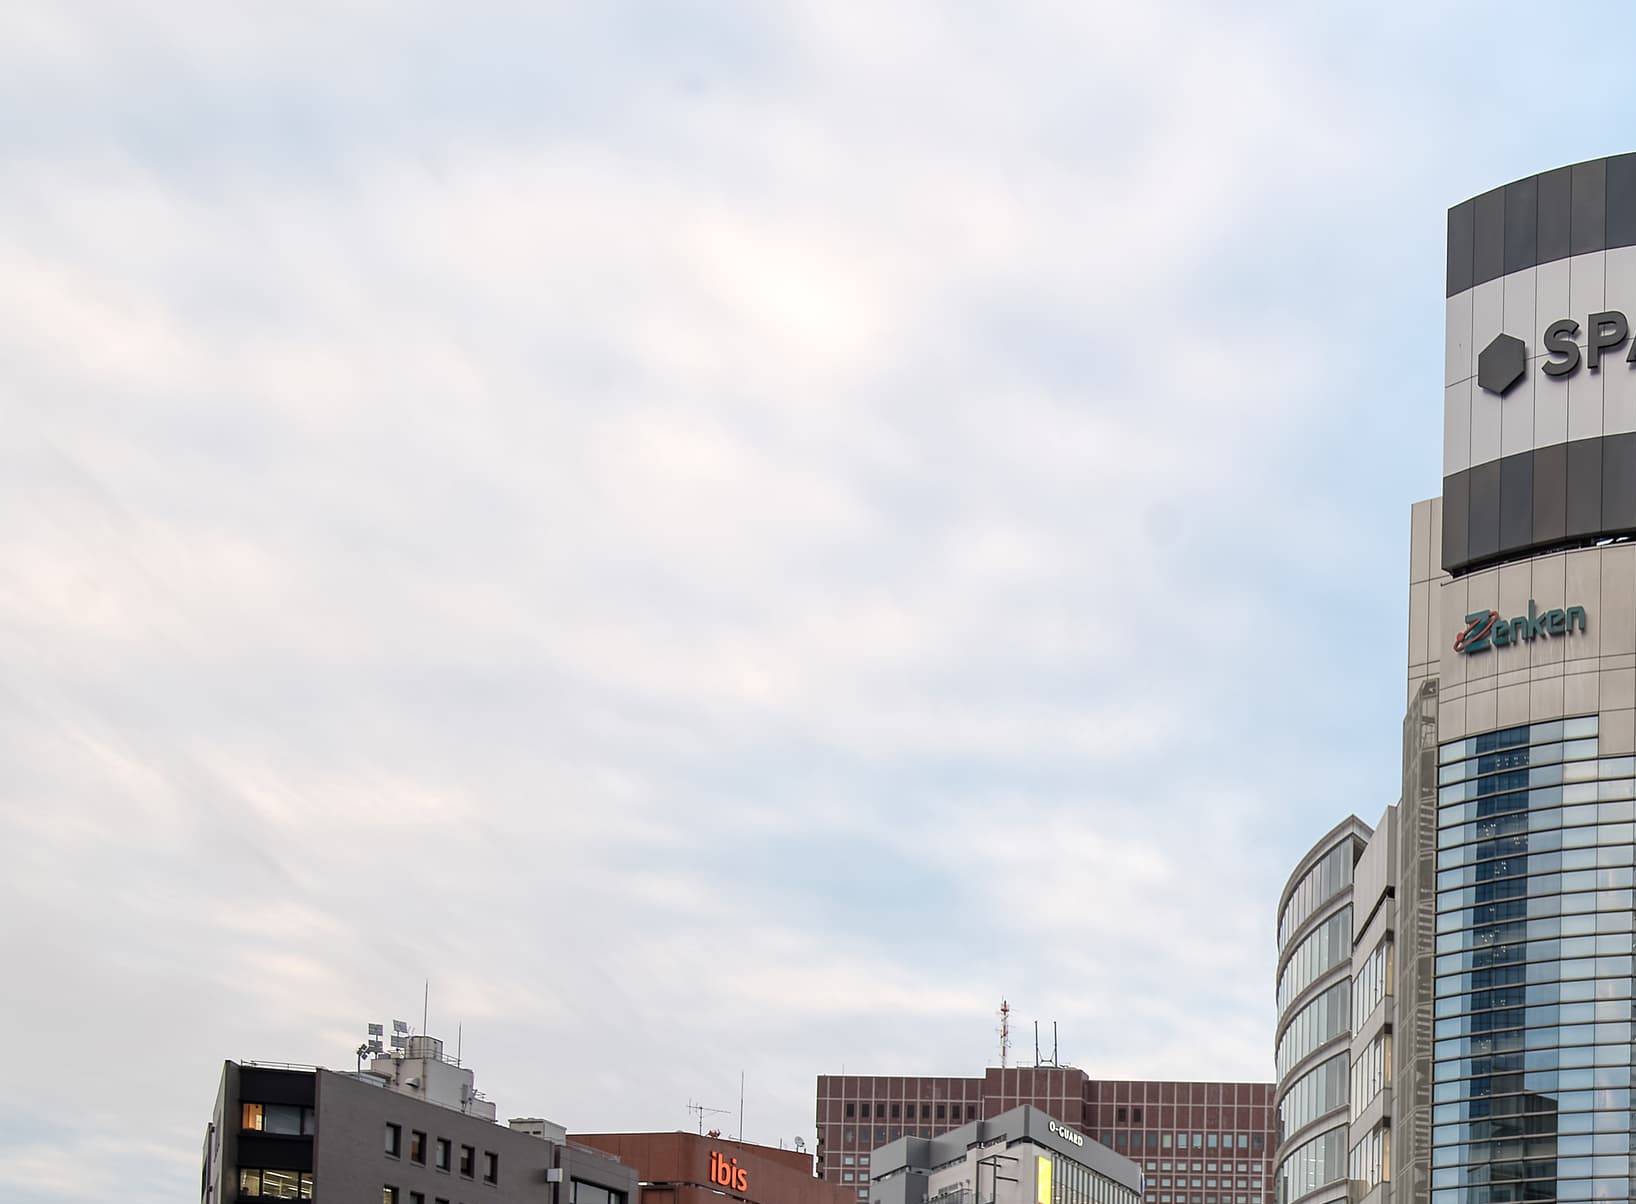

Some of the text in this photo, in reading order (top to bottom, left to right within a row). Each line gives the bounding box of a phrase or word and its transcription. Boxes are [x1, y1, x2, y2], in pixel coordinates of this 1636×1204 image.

[1462, 600, 1586, 652] Zenken
[1049, 1120, 1084, 1147] O-GUARD
[710, 1151, 748, 1192] ibis
